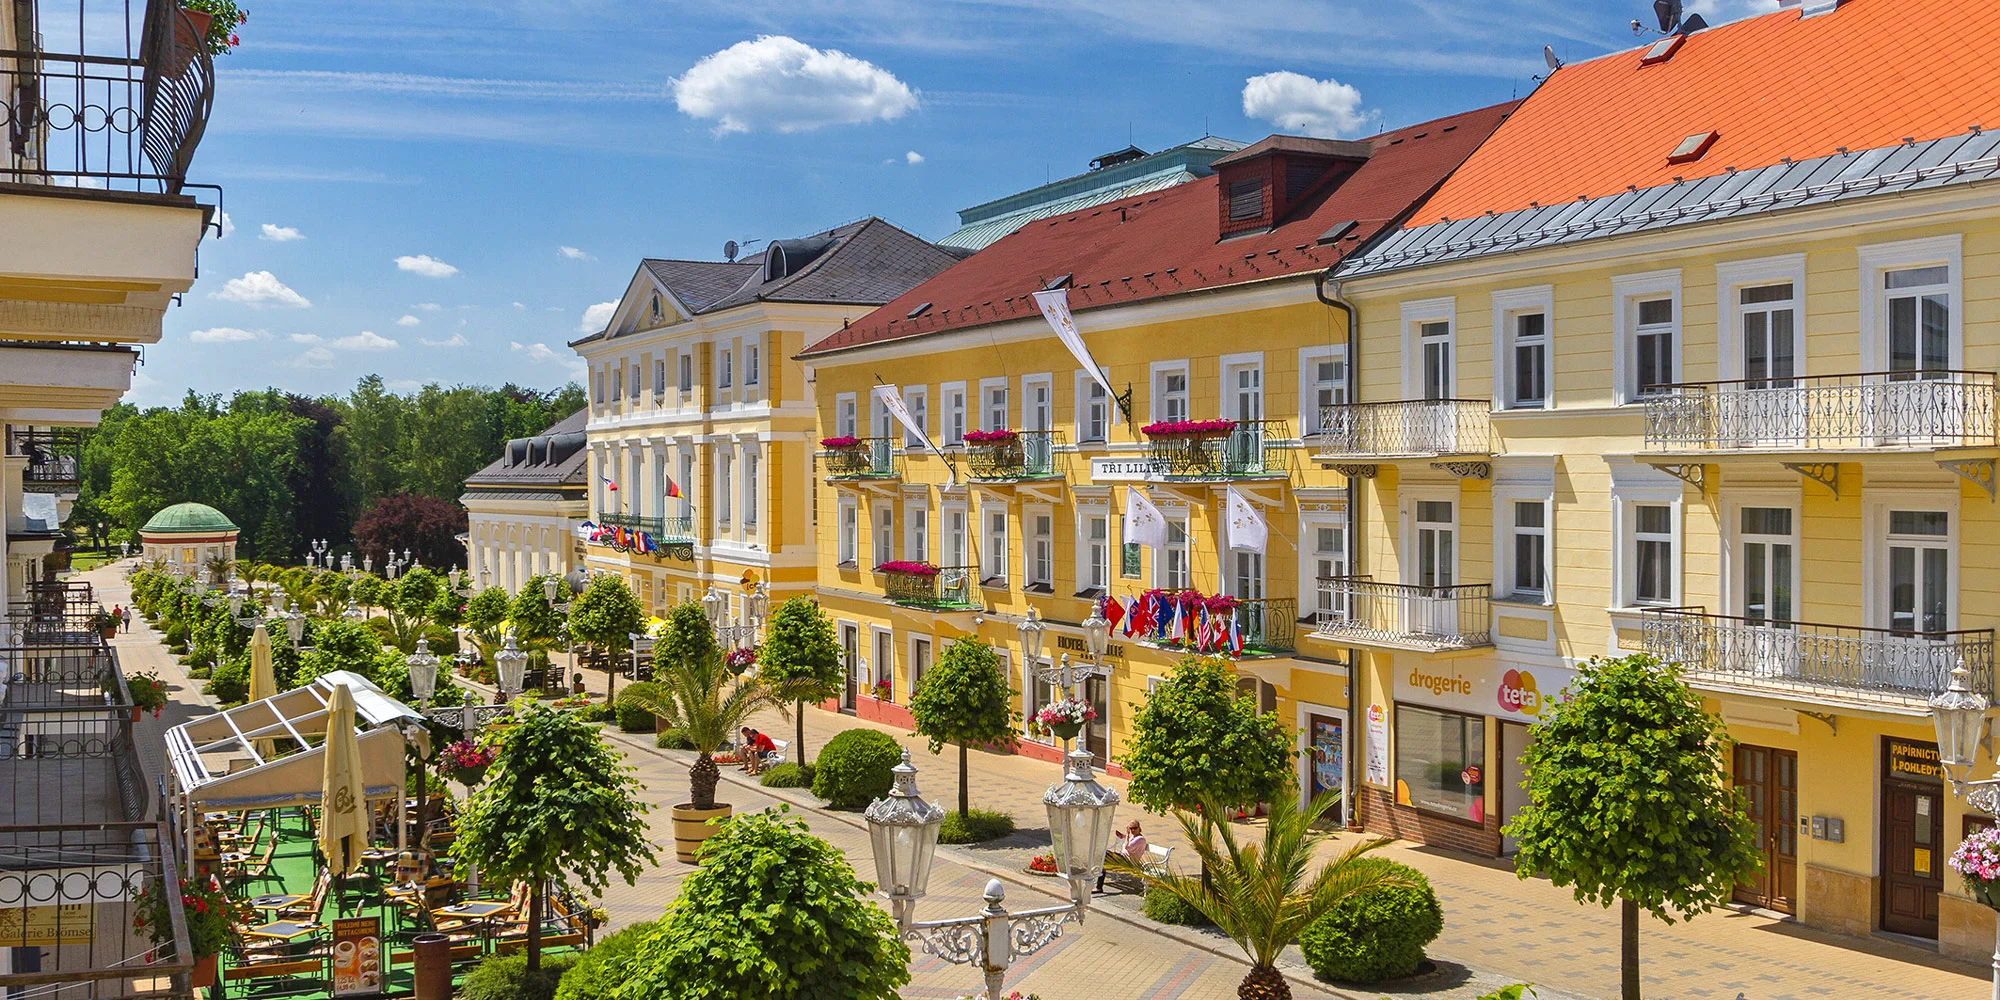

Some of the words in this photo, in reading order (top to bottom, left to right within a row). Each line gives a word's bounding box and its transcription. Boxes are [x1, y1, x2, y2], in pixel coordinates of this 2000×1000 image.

[1102, 462, 1122, 473] TŘI
[1057, 636, 1085, 651] HOTEL
[1409, 667, 1471, 696] drogerie
[1503, 684, 1537, 707] teta
[1892, 744, 1942, 761] PAPÍRNICTV
[1899, 760, 1938, 776] POHLEDY
[0, 928, 43, 939] Galerie
